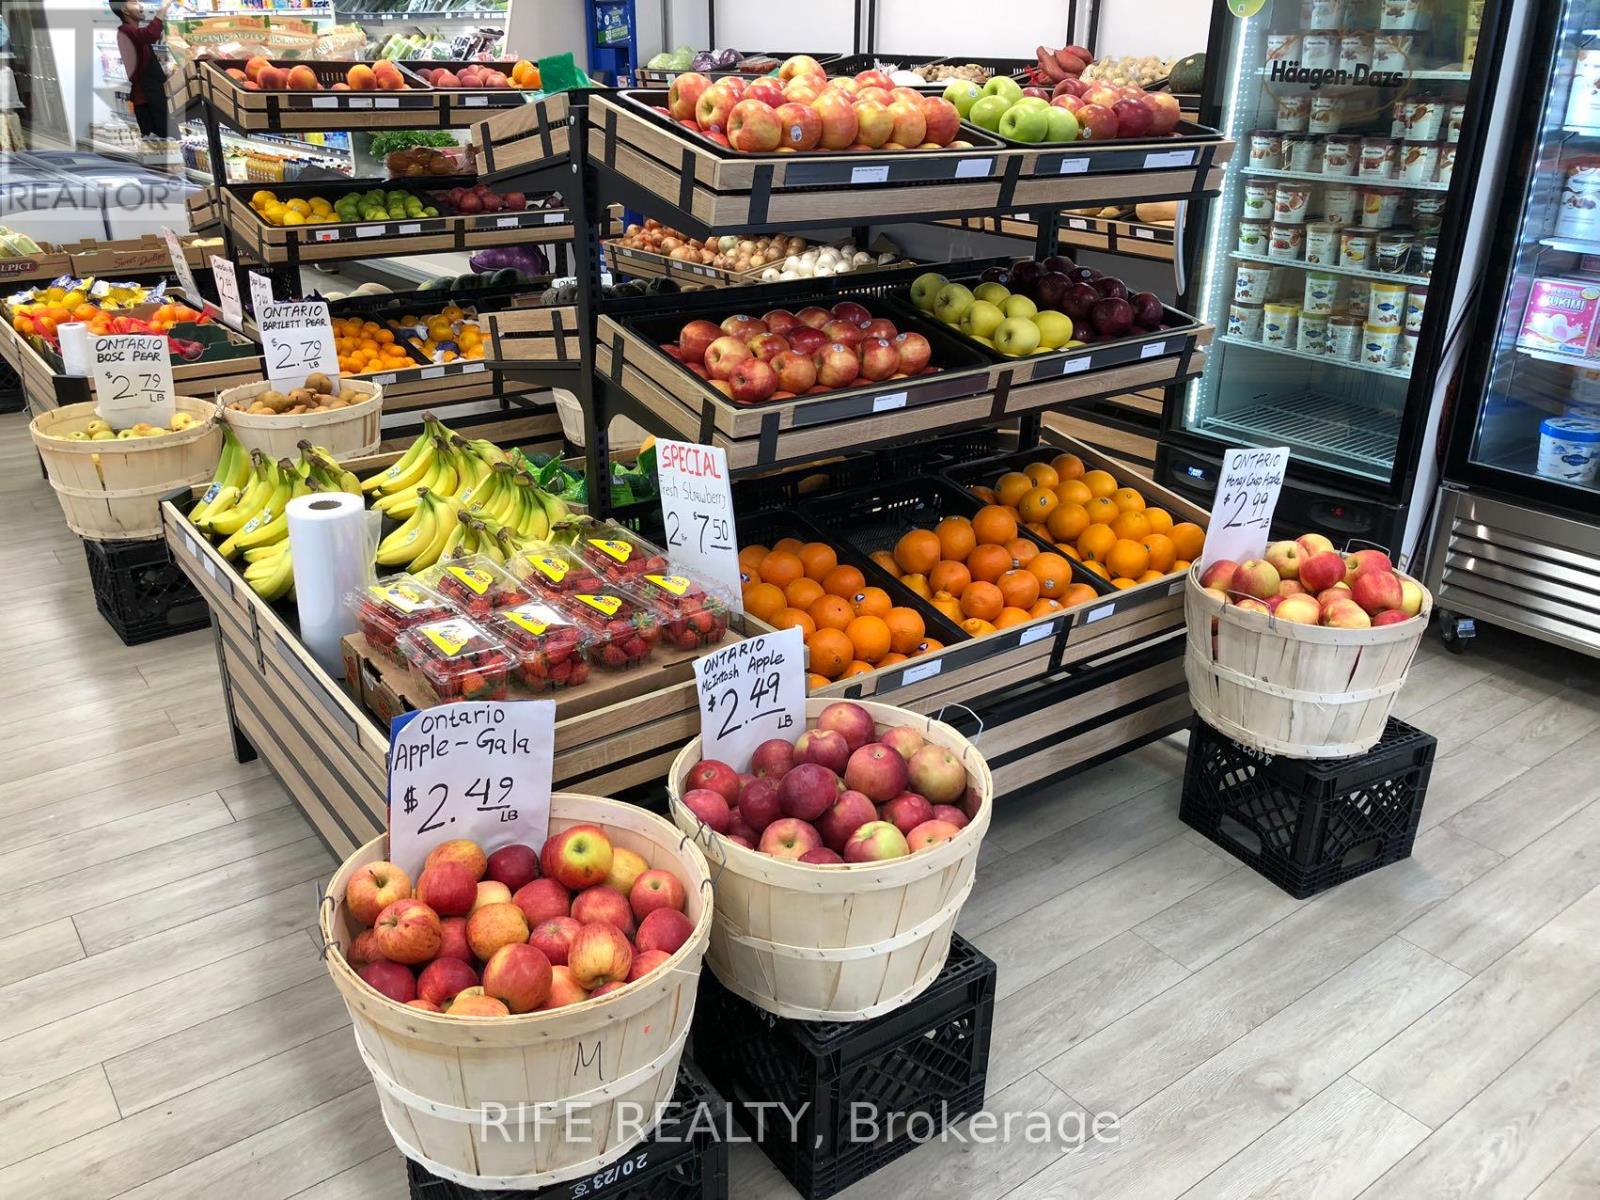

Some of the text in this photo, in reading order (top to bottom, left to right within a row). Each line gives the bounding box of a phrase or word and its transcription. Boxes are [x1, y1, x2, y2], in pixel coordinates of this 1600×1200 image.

[263, 305, 322, 319] ONTARIO
[262, 318, 328, 332] BARTLETT PEAR
[95, 338, 163, 352] ONTARIO
[96, 350, 161, 364] BOSC PEAR
[308, 361, 320, 369] LB
[149, 393, 165, 403] LB
[662, 444, 722, 479] SPECIAL
[1232, 453, 1281, 471] ONTARIO
[703, 638, 765, 676] ONTARIO
[701, 649, 785, 694] McIntosh Apple
[777, 714, 793, 730] LB
[500, 810, 519, 823] LB
[573, 1040, 604, 1081] M
